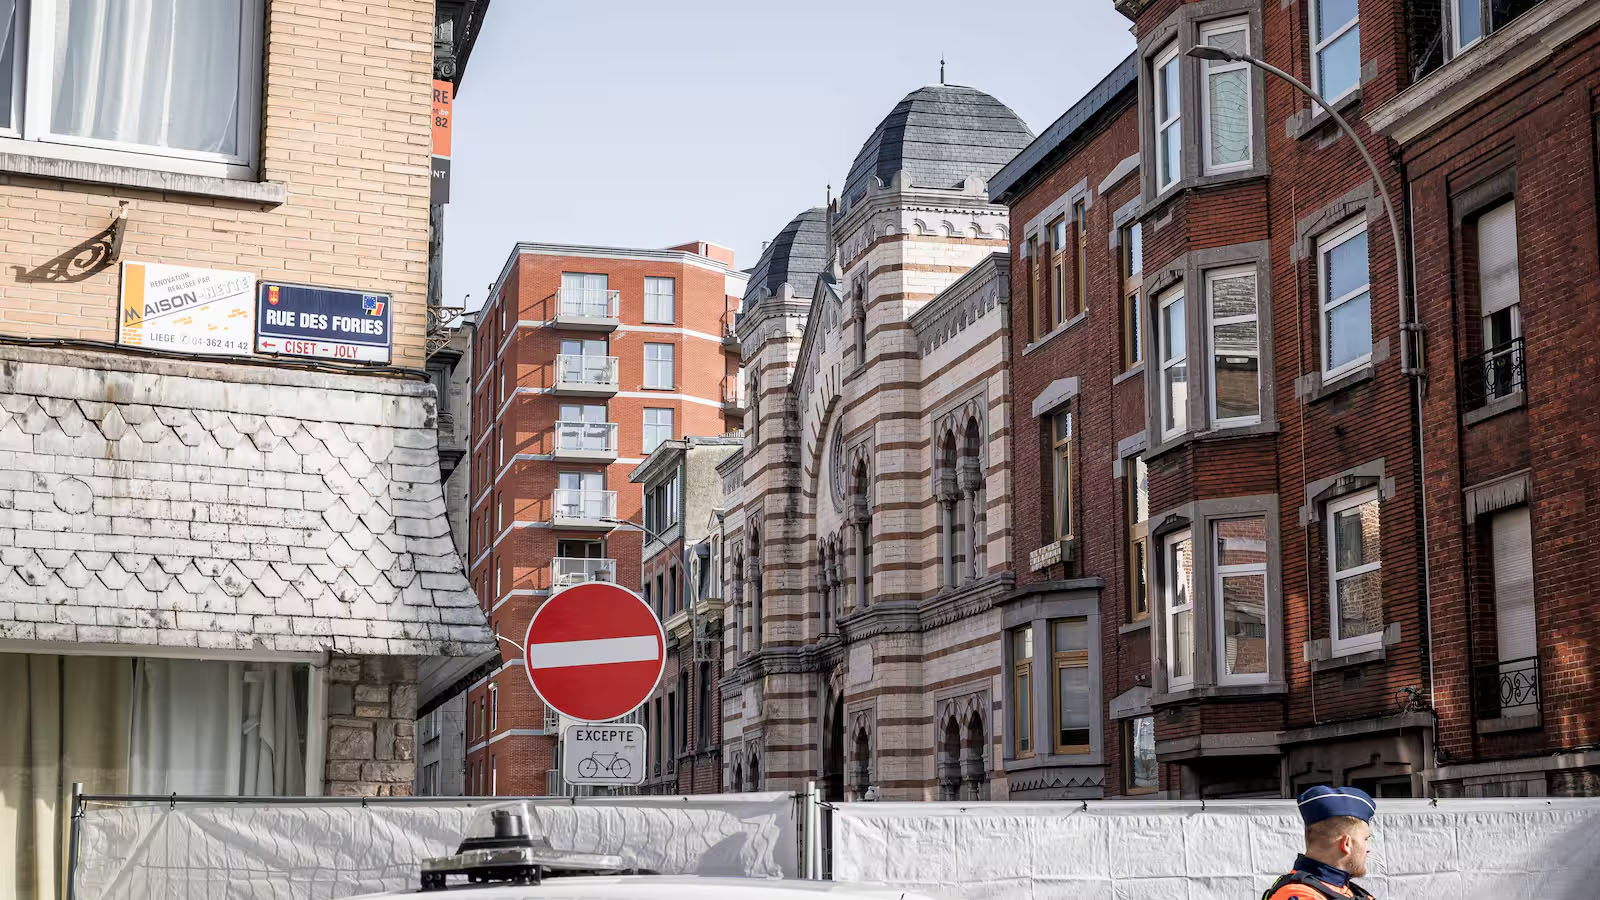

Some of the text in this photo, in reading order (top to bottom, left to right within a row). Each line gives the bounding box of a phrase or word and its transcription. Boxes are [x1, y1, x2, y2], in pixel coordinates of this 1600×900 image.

[435, 116, 448, 128] 82
[431, 169, 446, 179] NT
[197, 275, 211, 285] PAR
[266, 309, 384, 336] RUE DES FORIES
[150, 332, 175, 343] LIEGE
[224, 340, 234, 349] 41
[237, 342, 249, 350] 42
[285, 340, 317, 355] CISET
[334, 344, 359, 359] JOLY
[576, 730, 634, 742] EXCEPTE
